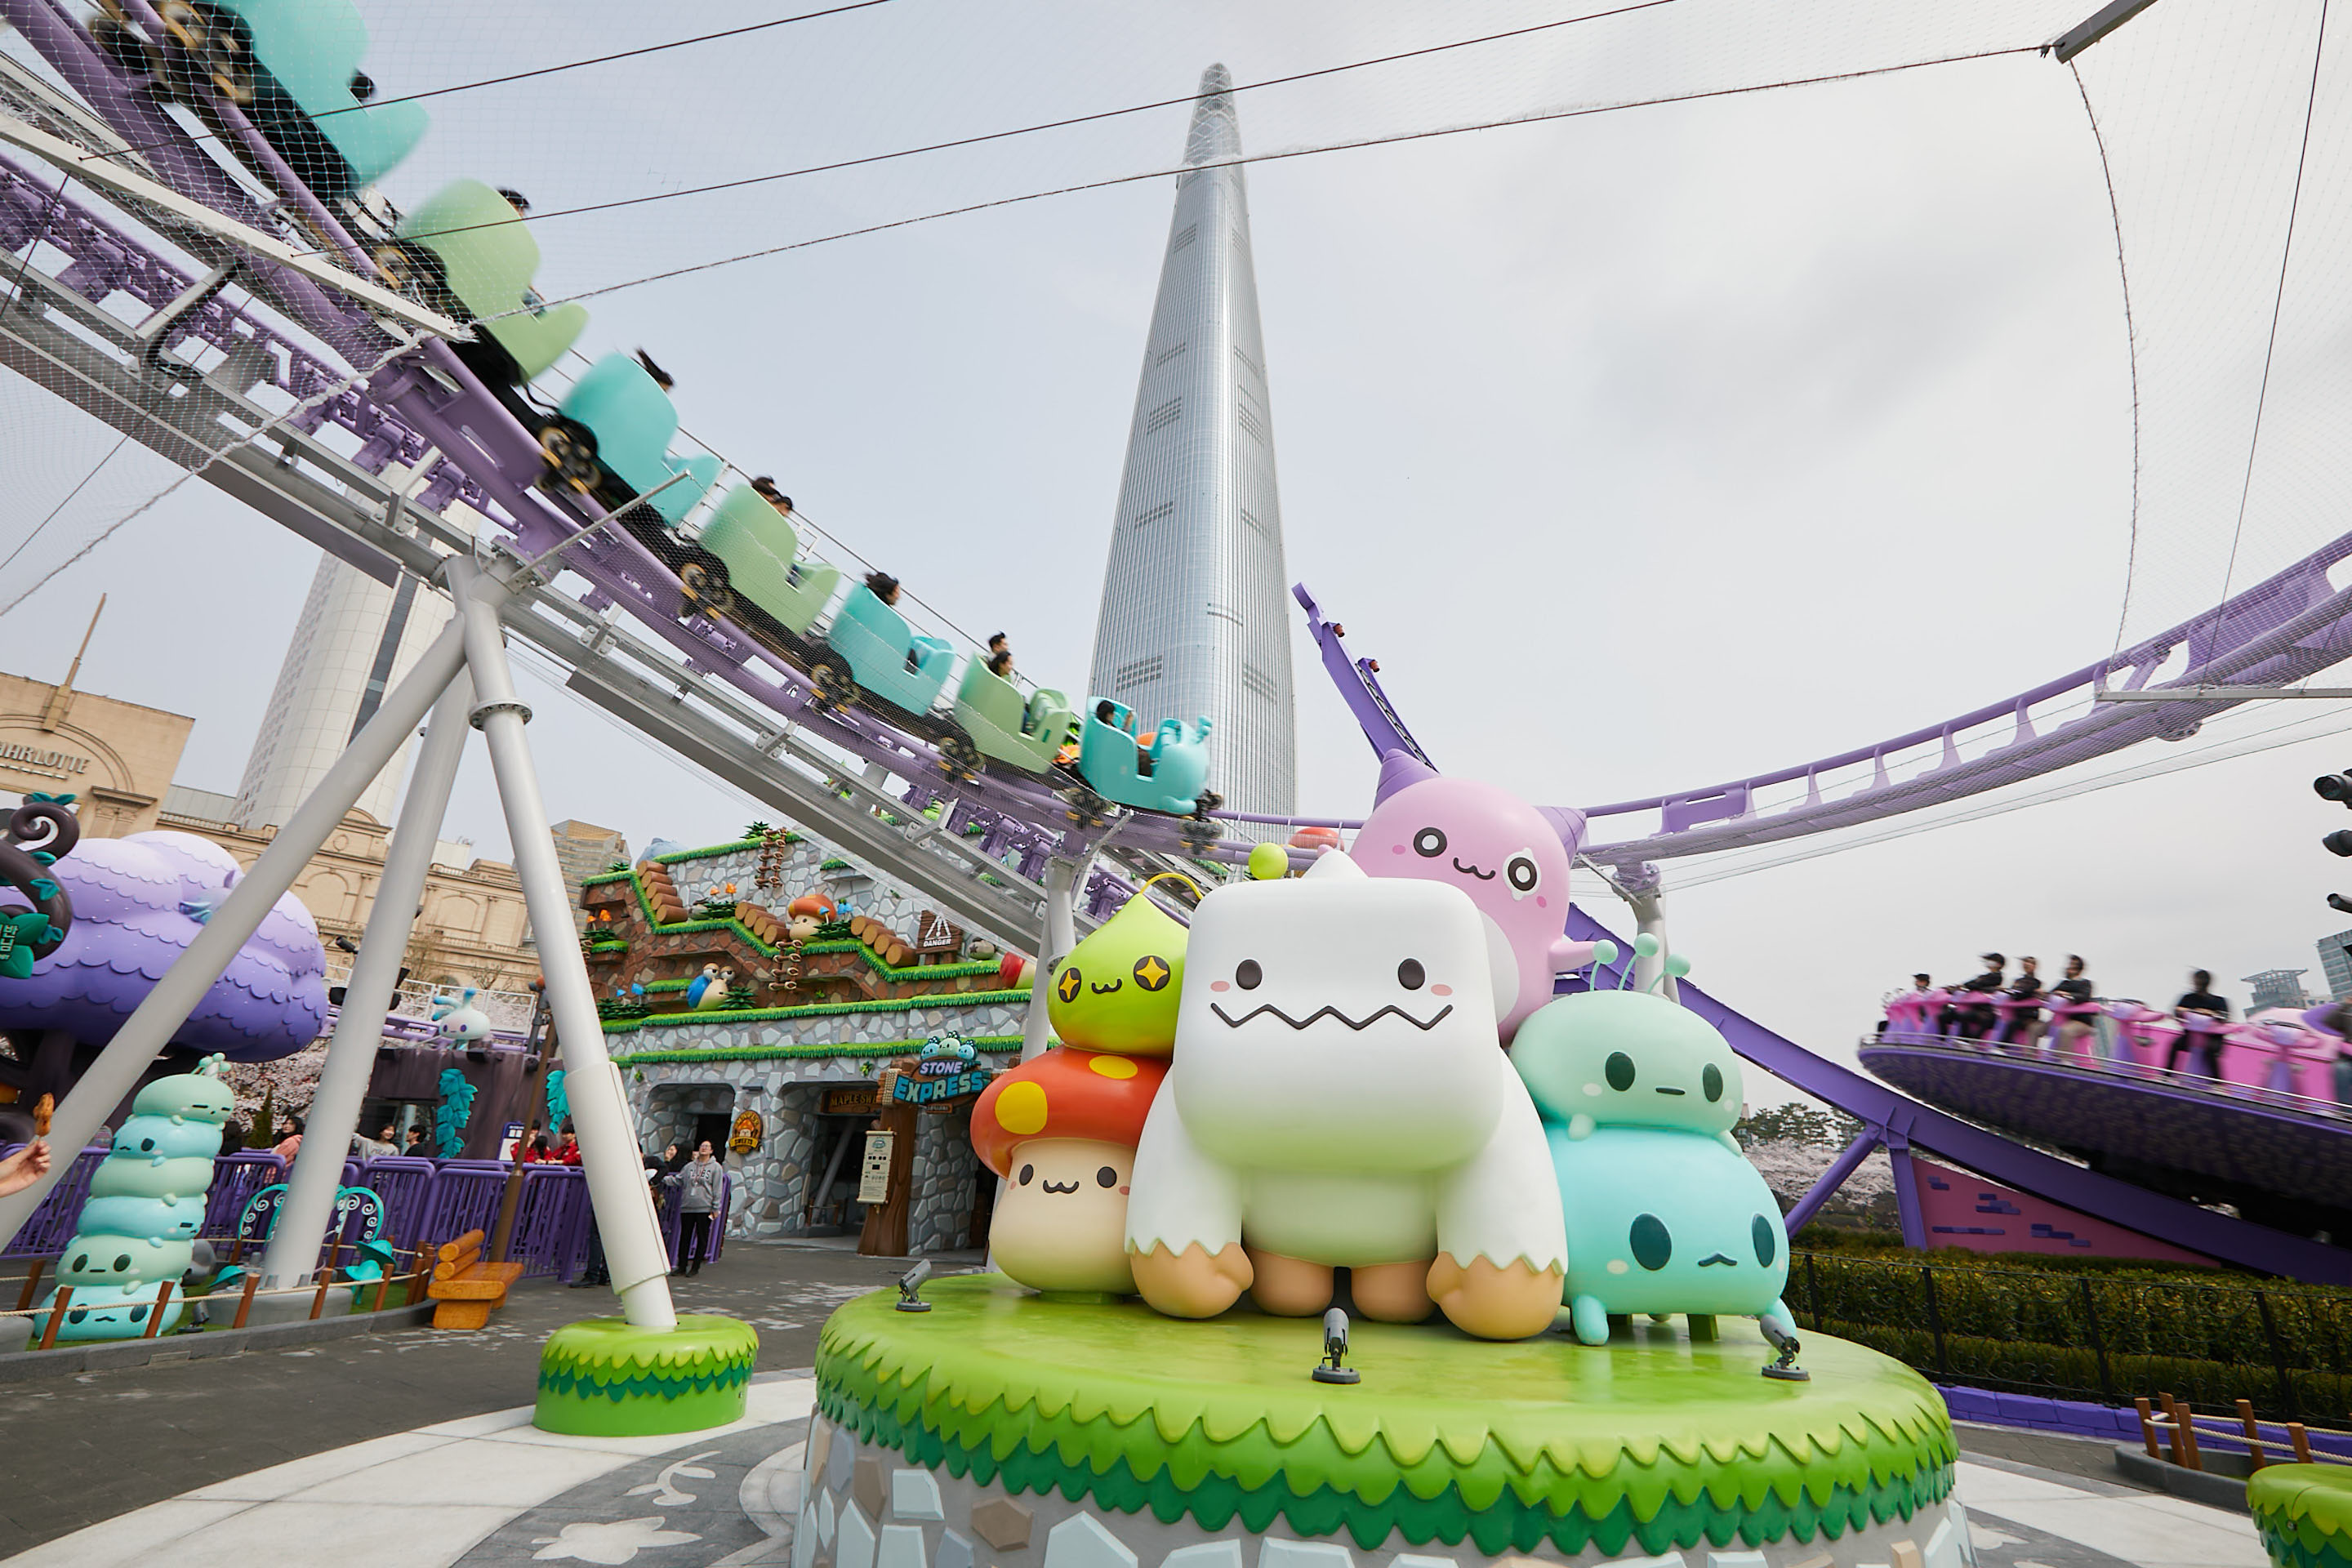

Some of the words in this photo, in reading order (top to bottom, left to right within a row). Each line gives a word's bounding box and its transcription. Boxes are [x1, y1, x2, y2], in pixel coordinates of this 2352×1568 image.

[923, 938, 951, 947] DANGER
[920, 1062, 963, 1074] STONE
[893, 1071, 984, 1102] EXPRESS
